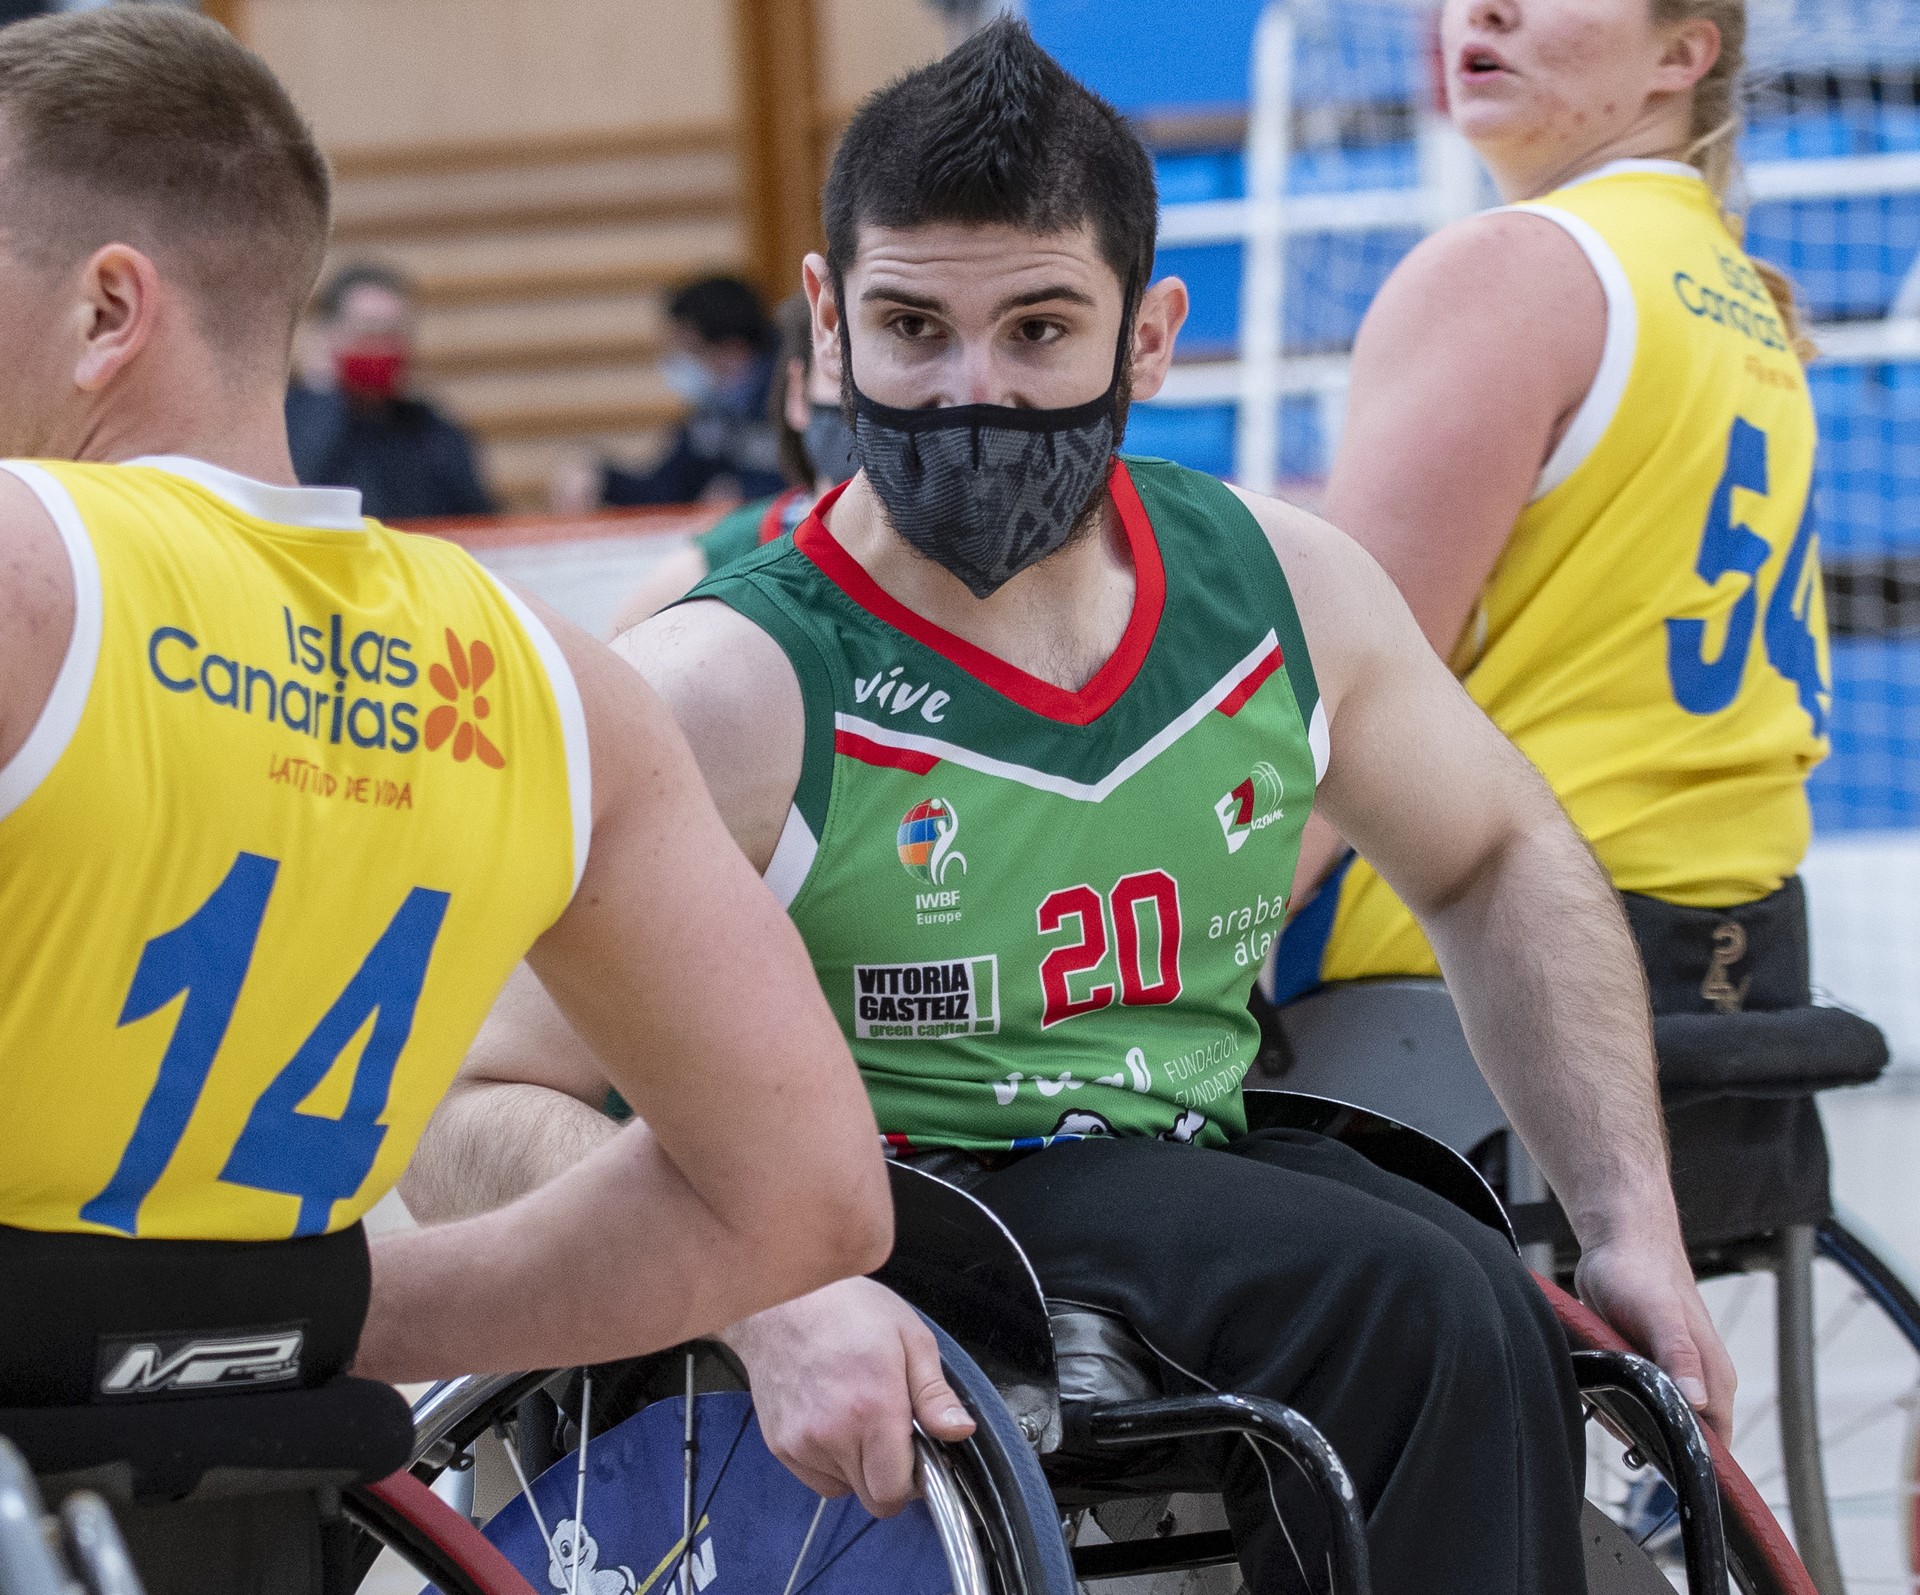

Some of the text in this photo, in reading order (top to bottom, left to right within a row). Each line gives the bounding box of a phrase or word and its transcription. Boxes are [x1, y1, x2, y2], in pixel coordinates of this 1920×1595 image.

[283, 605, 419, 688] Islas
[147, 625, 419, 754] Canarias
[915, 890, 961, 910] IWBF
[916, 911, 962, 925] Europe
[1208, 894, 1283, 939] araba
[1036, 868, 1184, 1032] 20
[1234, 929, 1277, 966] ála
[857, 963, 970, 995] VITORIA
[859, 993, 969, 1022] GASTEIZ
[78, 850, 453, 1240] 14
[869, 1021, 970, 1038] green capital
